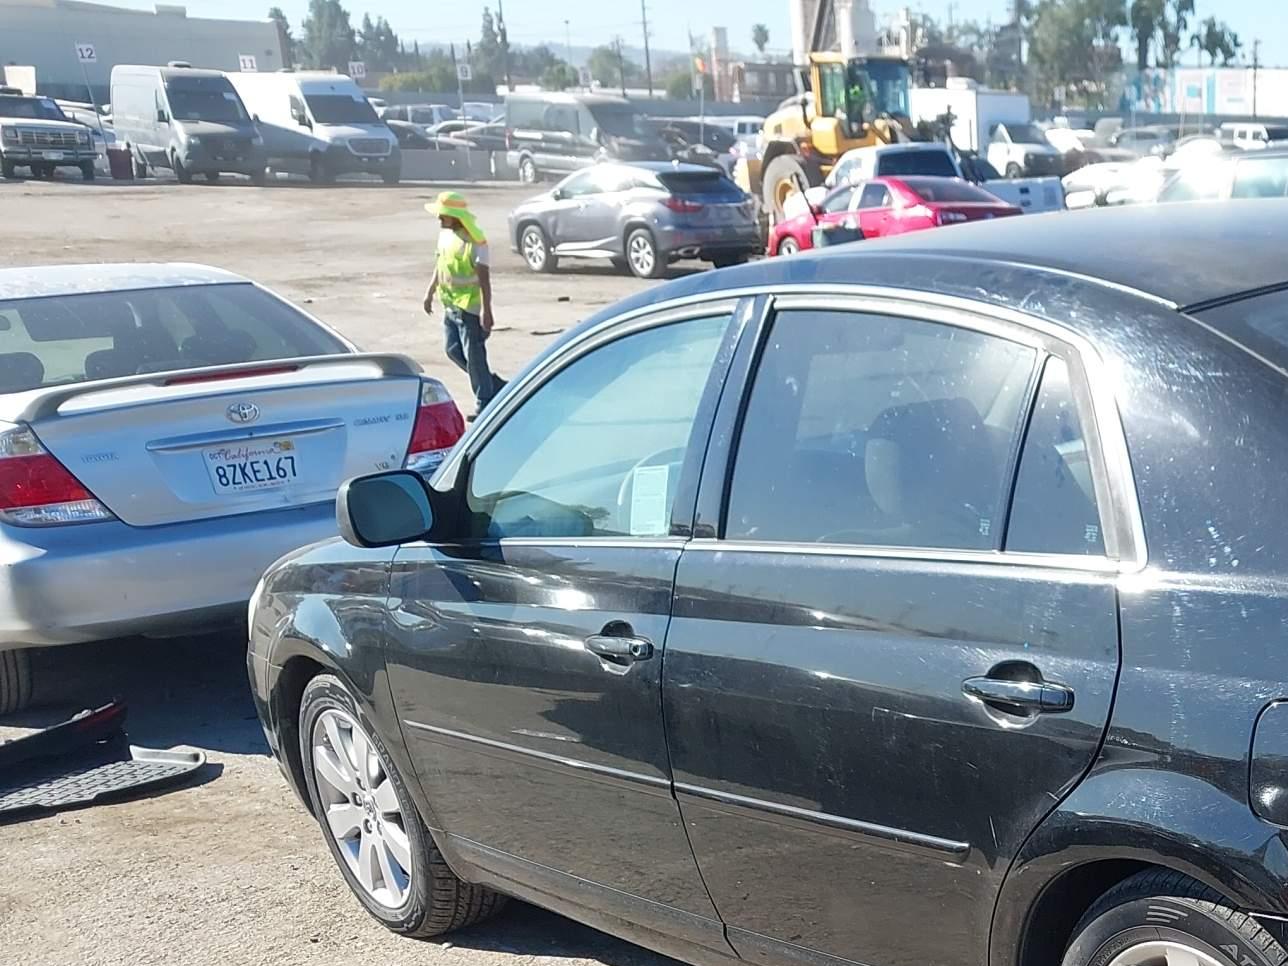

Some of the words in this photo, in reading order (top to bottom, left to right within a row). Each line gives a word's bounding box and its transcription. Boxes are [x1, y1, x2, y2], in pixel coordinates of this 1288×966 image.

[78, 47, 96, 60] 12
[241, 57, 256, 70] 11
[351, 64, 365, 76] 10
[223, 447, 283, 461] California
[215, 456, 297, 487] 8ZKE167
